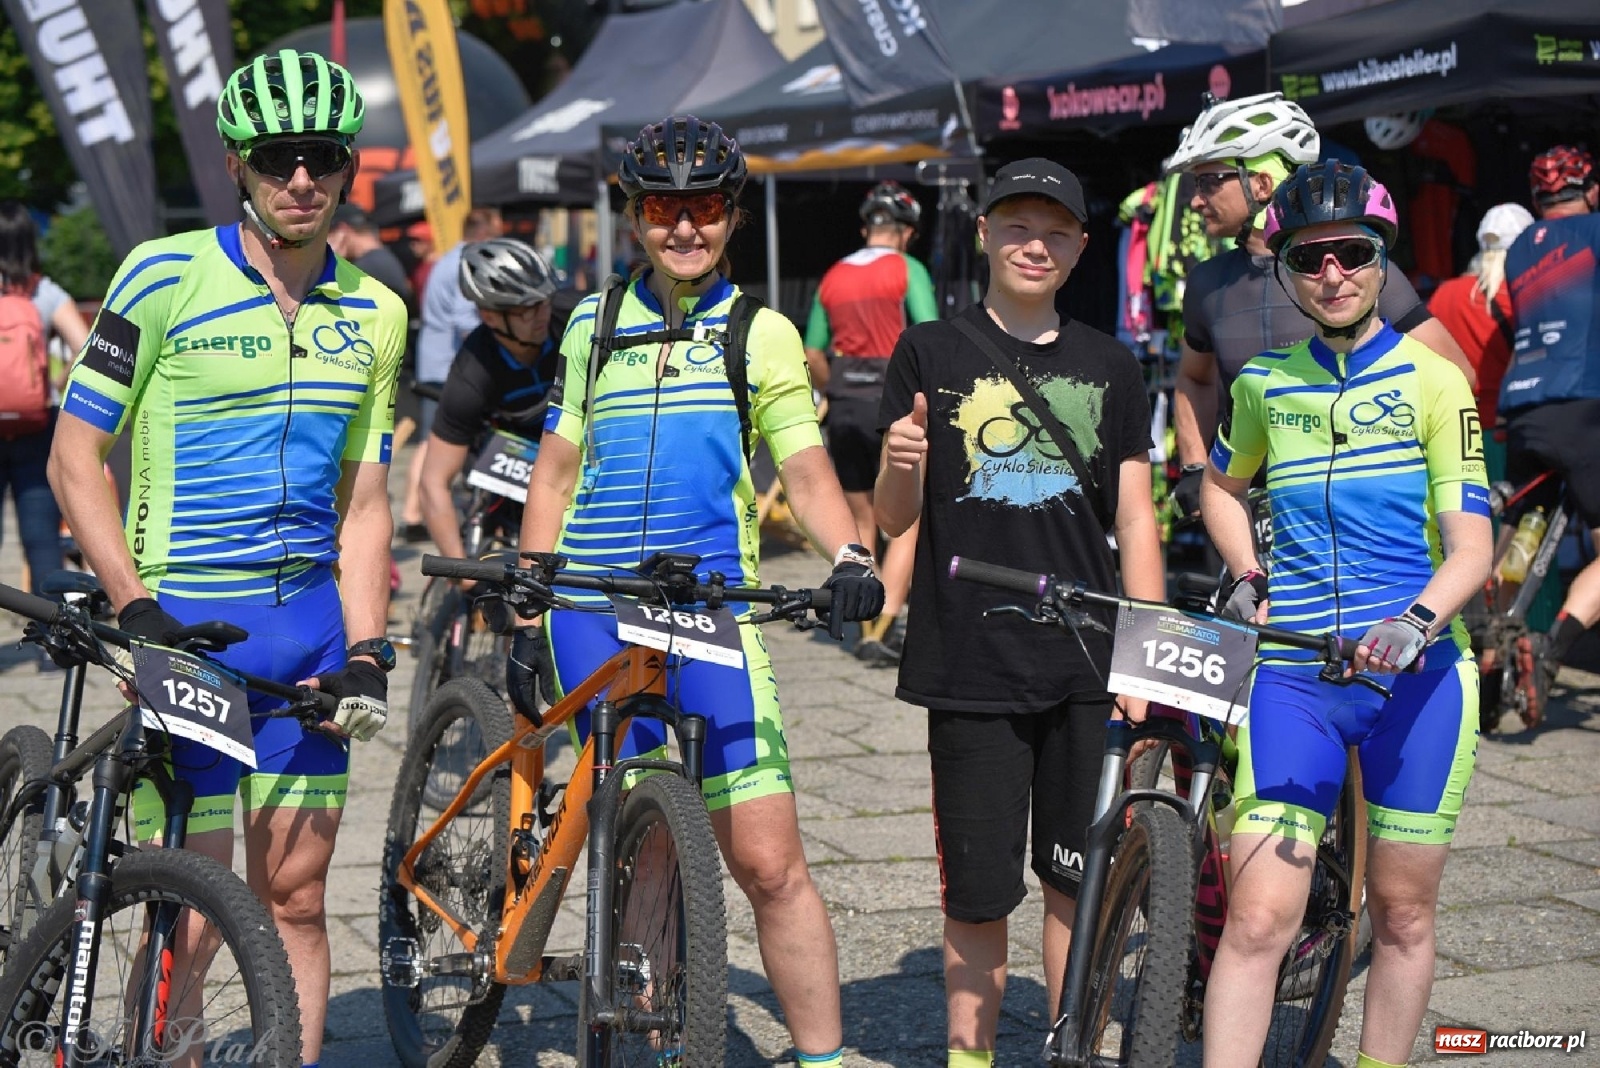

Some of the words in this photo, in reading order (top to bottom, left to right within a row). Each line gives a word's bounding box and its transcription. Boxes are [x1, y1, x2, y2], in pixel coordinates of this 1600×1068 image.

[91, 332, 135, 367] VeroNA
[174, 335, 272, 359] Energo
[140, 410, 151, 461] meble
[1268, 406, 1321, 433] Energo
[981, 458, 1073, 477] CykloSilesia
[638, 605, 717, 634] 1268
[1143, 640, 1227, 685] 1256
[163, 678, 231, 724] 1257
[64, 920, 95, 1044] manitou
